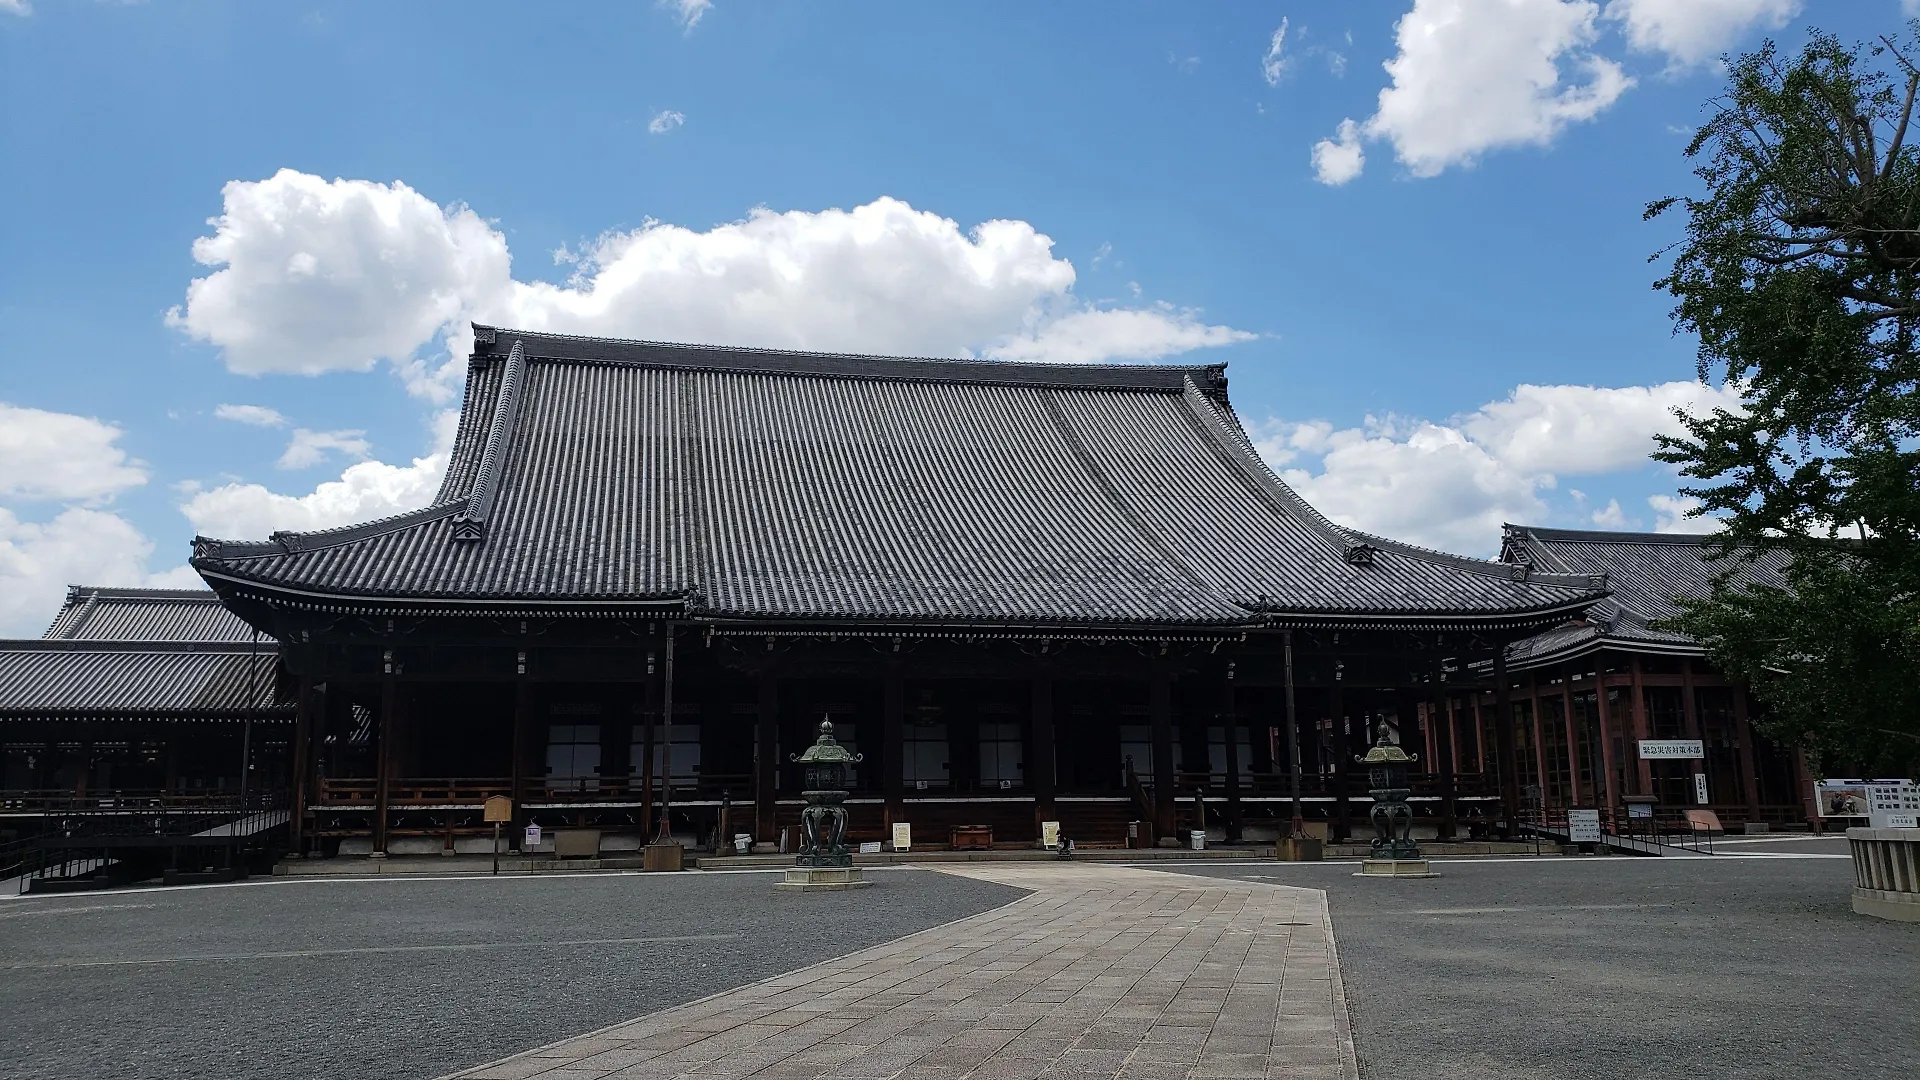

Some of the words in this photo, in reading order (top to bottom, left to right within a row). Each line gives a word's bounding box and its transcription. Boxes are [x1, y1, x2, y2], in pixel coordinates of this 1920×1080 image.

[1643, 745, 1701, 755] 緊急災害対策本部
